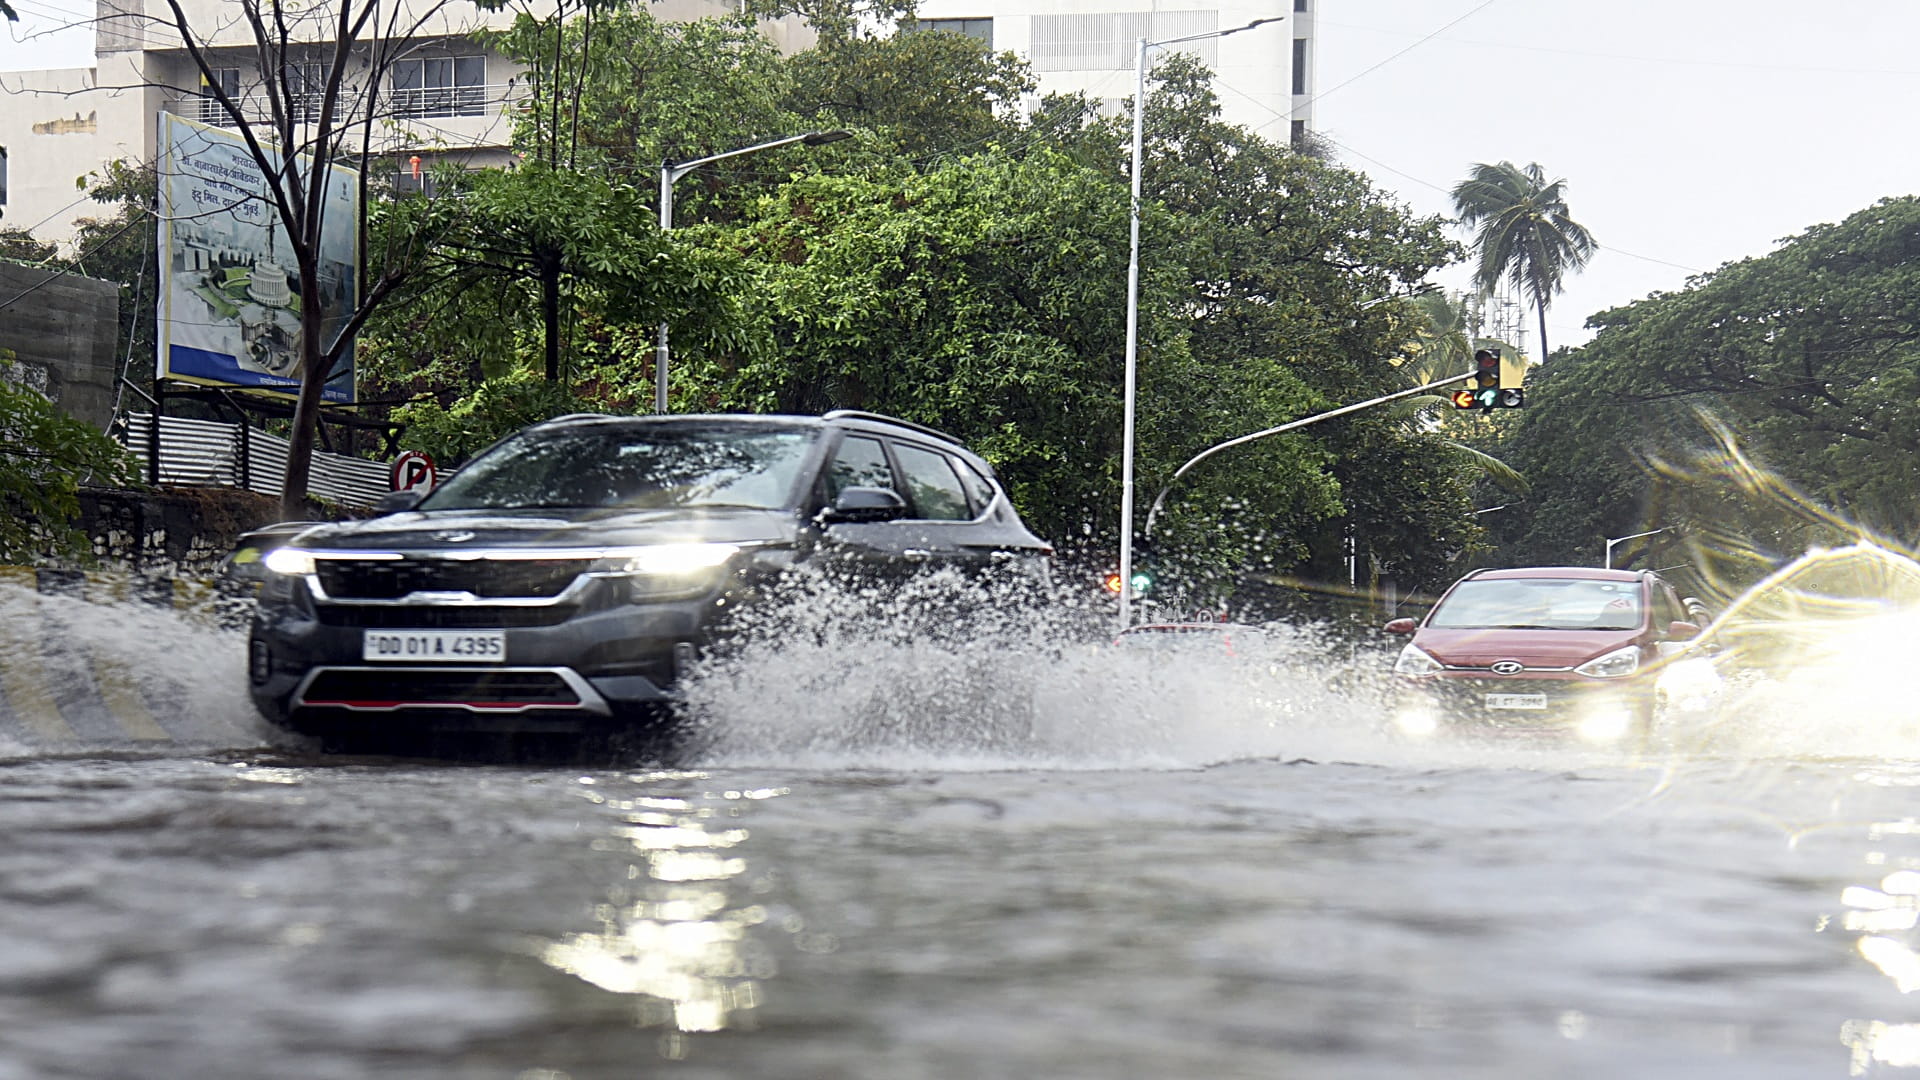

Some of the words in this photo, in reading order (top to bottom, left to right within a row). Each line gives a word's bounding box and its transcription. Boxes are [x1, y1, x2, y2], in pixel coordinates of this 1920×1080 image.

[194, 160, 228, 177] बाबासाहेब
[378, 636, 401, 654] DD
[407, 637, 428, 654] 01
[433, 637, 444, 654] A
[451, 637, 501, 655] 4395
